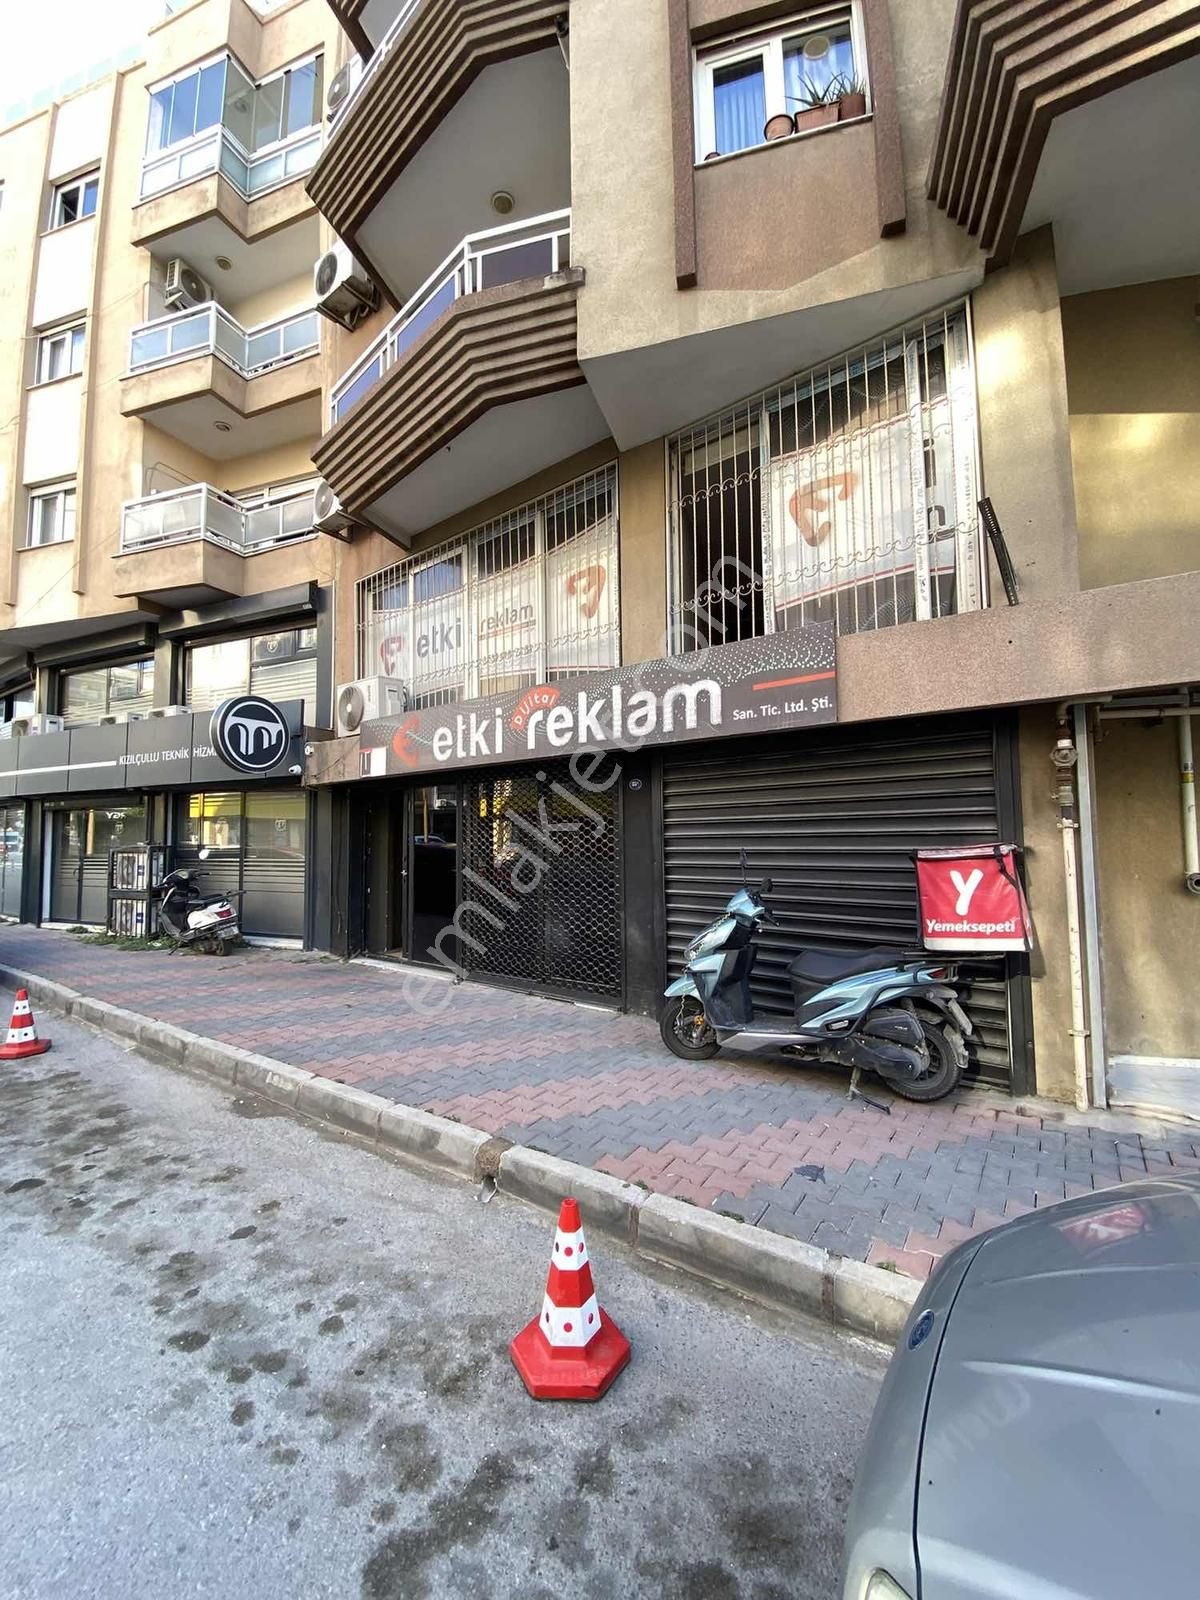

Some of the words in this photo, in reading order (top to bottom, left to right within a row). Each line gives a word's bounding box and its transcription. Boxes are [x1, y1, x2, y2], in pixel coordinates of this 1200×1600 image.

[416, 617, 462, 658] etki
[479, 603, 534, 632] reklam
[432, 707, 503, 761] etki
[527, 679, 722, 751] reklam
[732, 709, 758, 721] San.
[760, 705, 781, 717] Tic.
[785, 699, 808, 714] Ltd.
[811, 696, 833, 713] Şti.
[119, 752, 160, 766] KIZILÇULLU
[162, 746, 189, 761] TEKNİK
[193, 744, 217, 758] HİZM
[949, 868, 984, 916] Y
[925, 918, 1016, 935] Yemeksepeti
